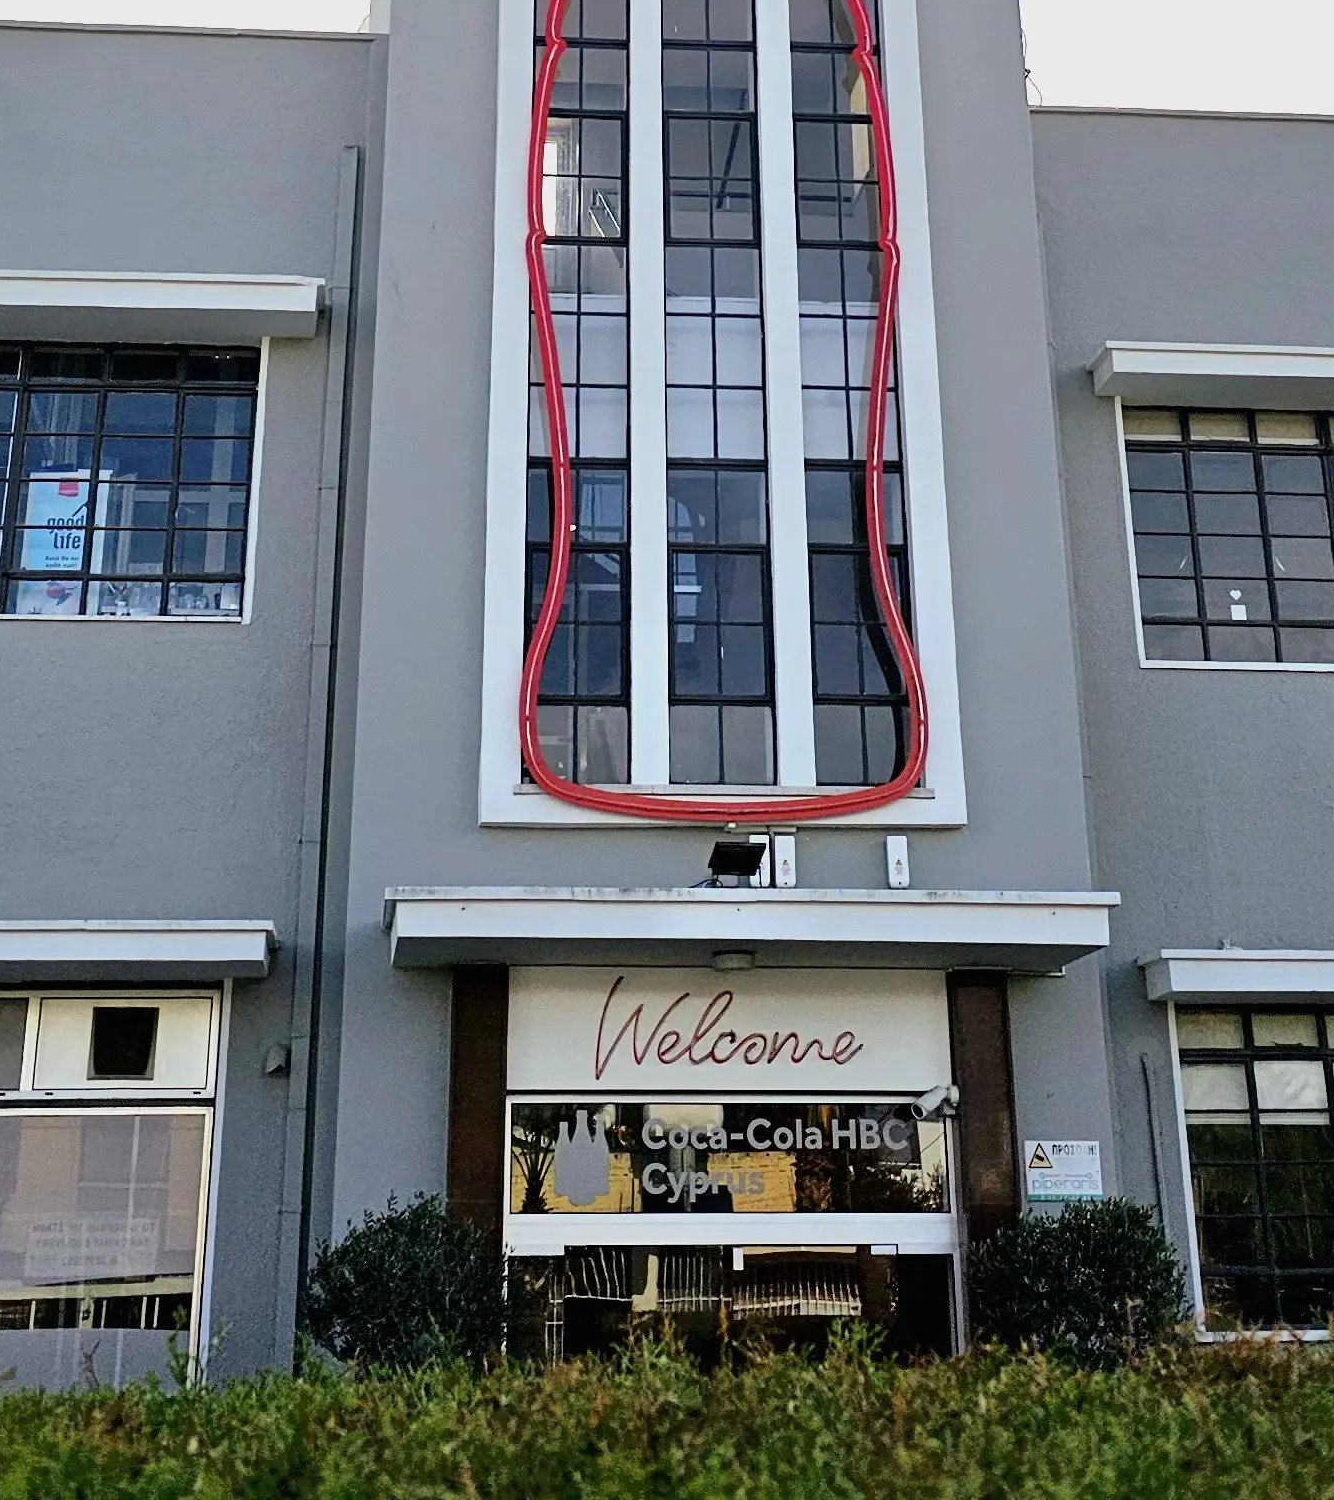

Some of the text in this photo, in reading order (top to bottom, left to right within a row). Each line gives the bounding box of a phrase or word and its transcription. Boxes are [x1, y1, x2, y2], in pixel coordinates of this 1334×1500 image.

[47, 515, 84, 534] good
[53, 532, 81, 549] life
[595, 975, 864, 1080] Welcome
[642, 1118, 910, 1150] Coca-Cola HBC
[642, 1162, 766, 1203] Cyprus
